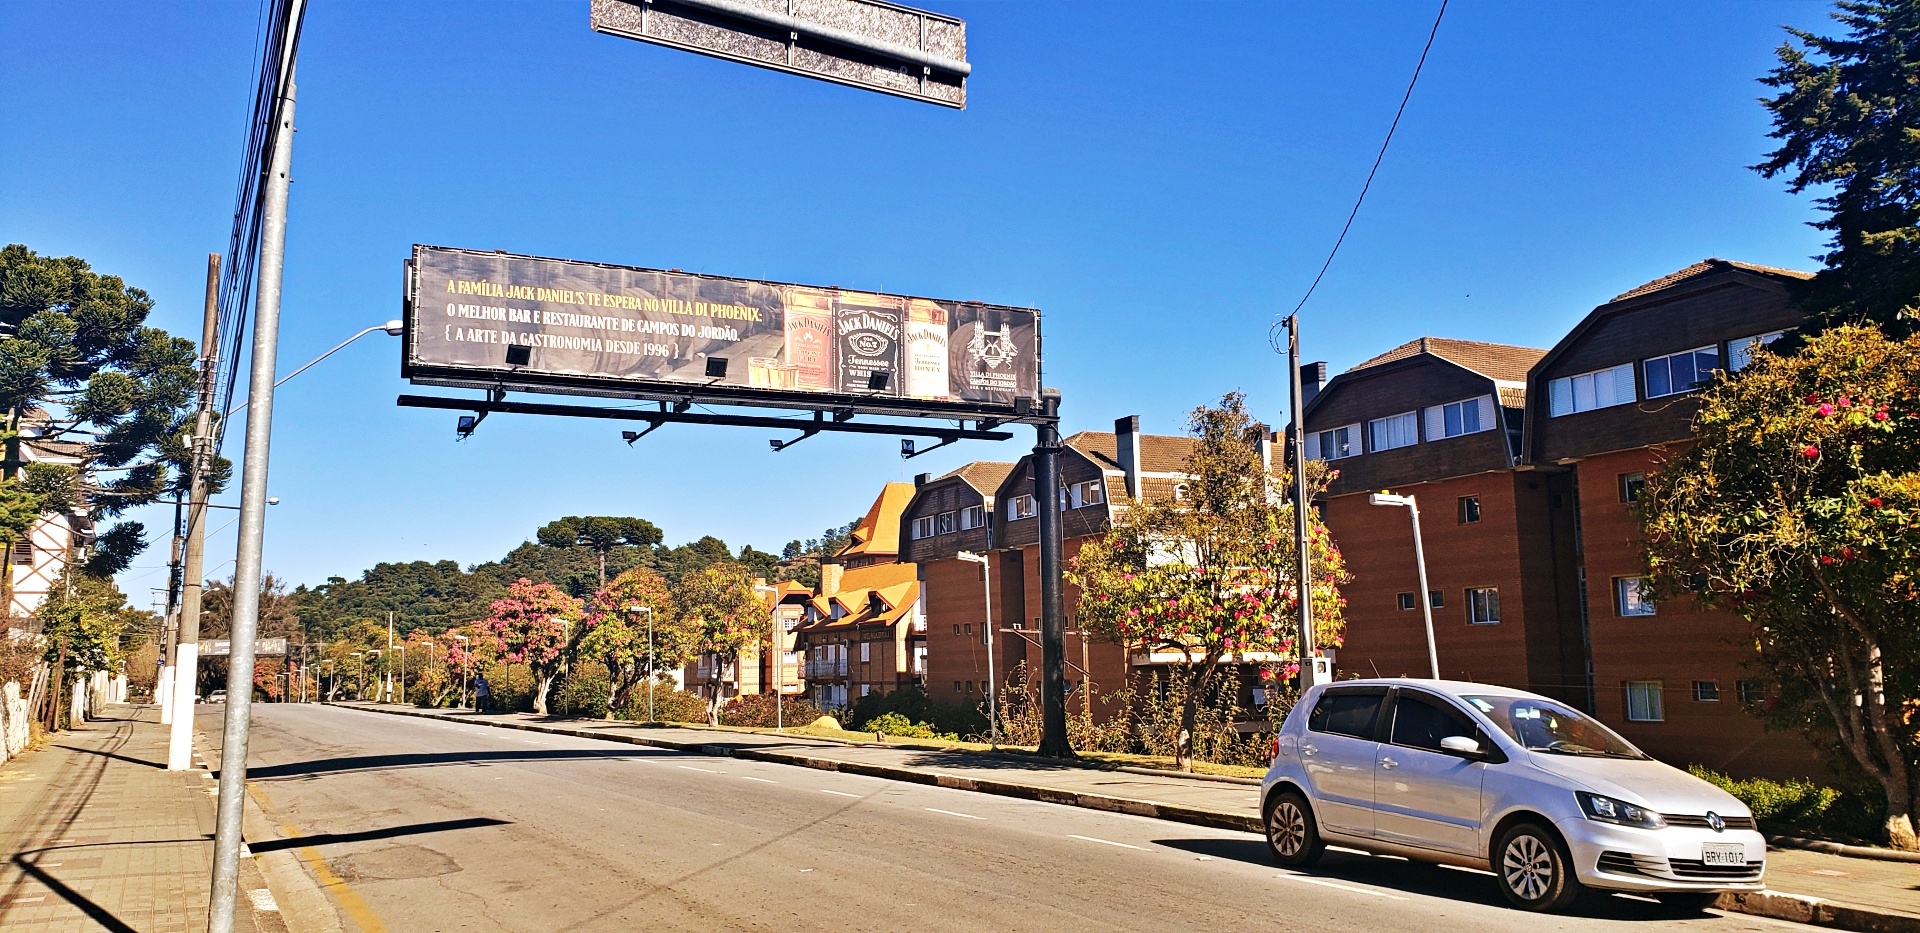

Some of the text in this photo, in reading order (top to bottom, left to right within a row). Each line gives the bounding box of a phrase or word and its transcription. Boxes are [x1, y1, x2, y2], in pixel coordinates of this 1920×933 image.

[447, 279, 762, 322] A FAMÍLIA JACK DANIEL'S TE ESPERA NO VILLA DI PHOENIX:
[446, 302, 740, 342] O MELHOR BAR E RESTAURANTE DE CAMPOS DO JORDÃO.
[838, 313, 900, 340] JACK DANIEL'S
[456, 328, 464, 341] A
[467, 328, 498, 344] ARTE
[501, 331, 516, 345] DA
[520, 332, 602, 352] GASTRONOMIA
[606, 340, 640, 354] DESDE
[644, 342, 670, 358] 1996
[848, 354, 890, 367] Tennessee
